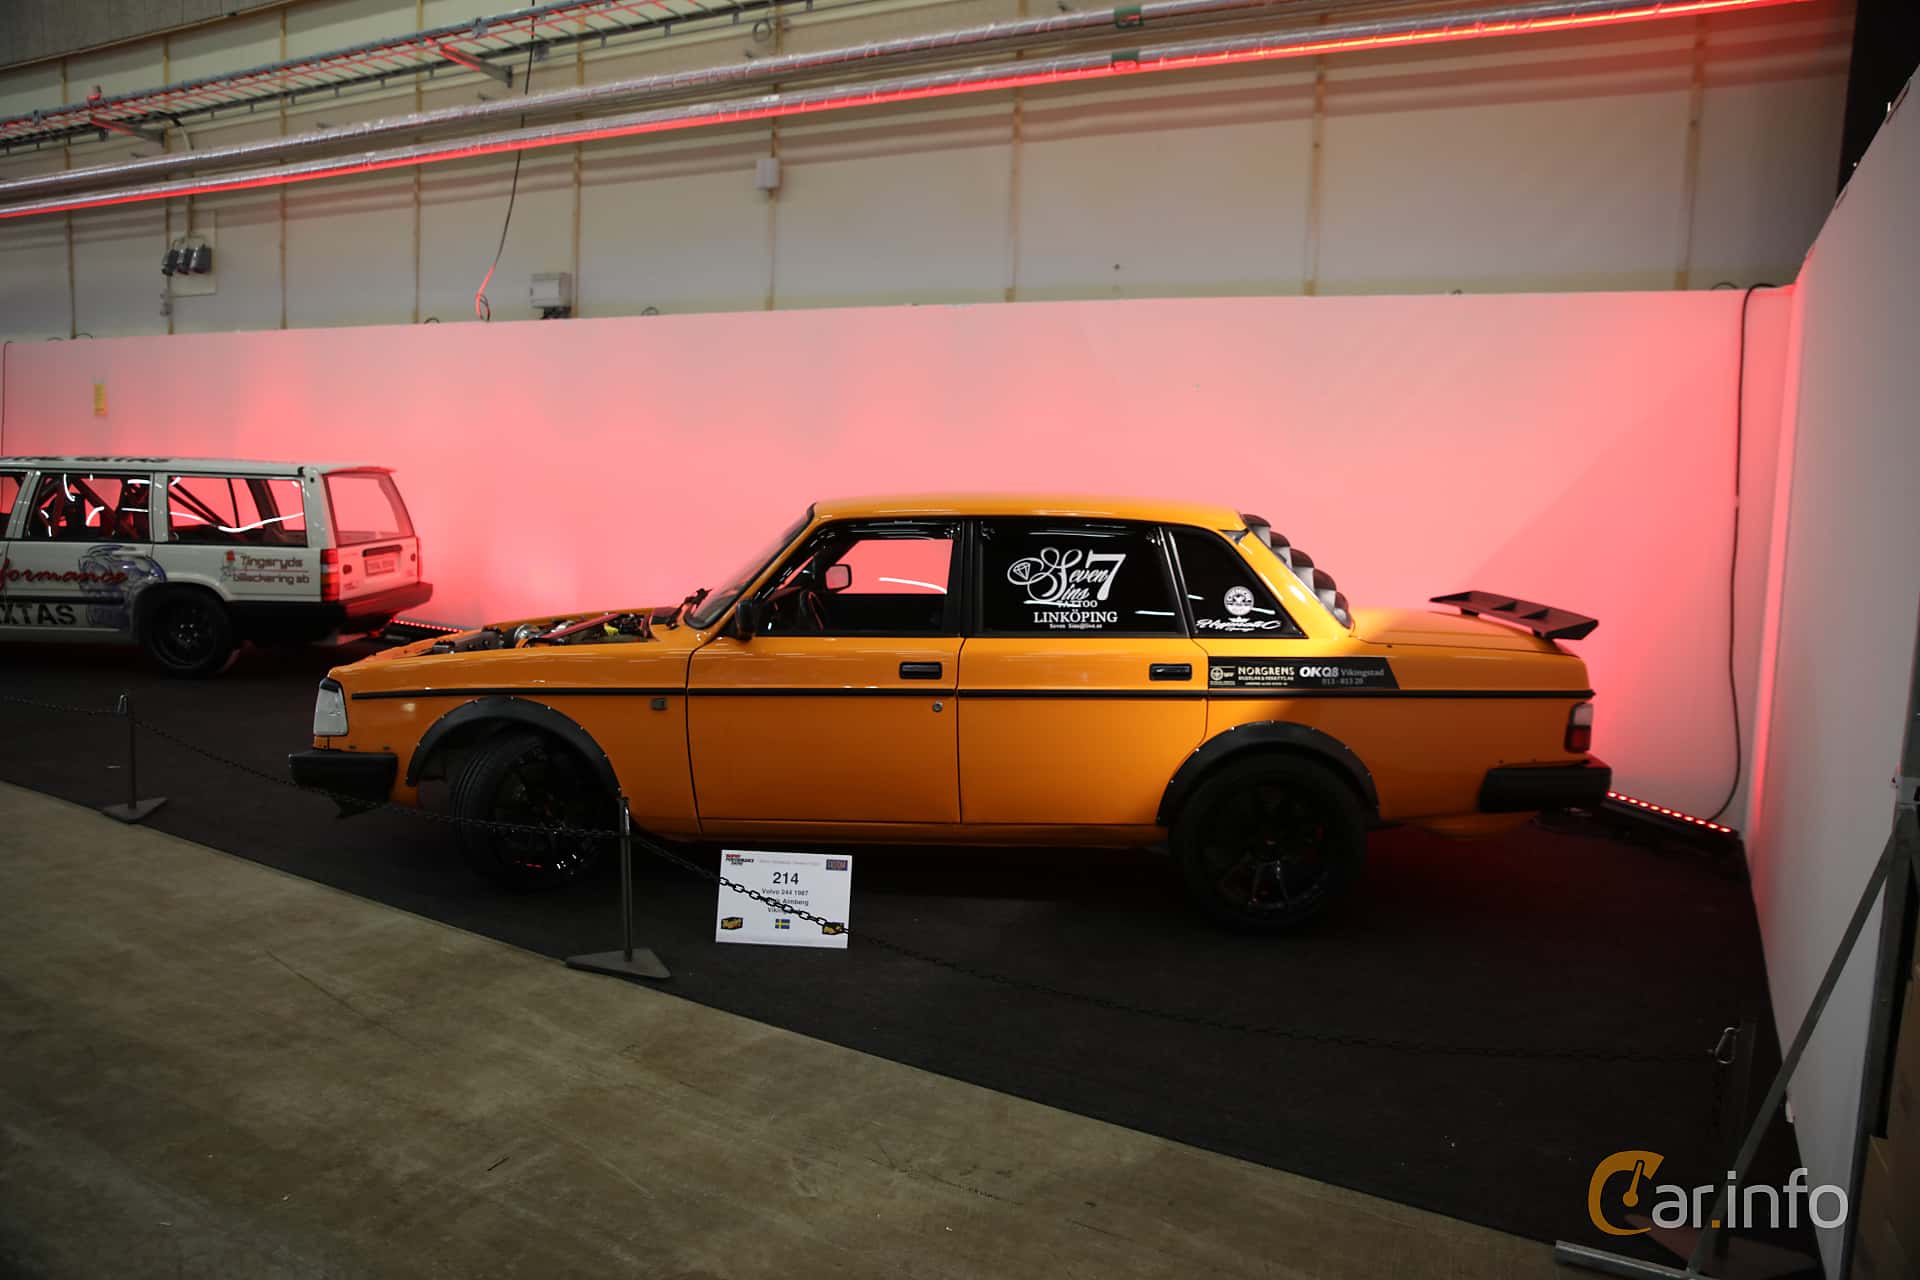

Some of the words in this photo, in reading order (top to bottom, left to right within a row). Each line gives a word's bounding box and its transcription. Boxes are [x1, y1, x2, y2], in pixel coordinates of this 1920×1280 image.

[1085, 549, 1127, 601] 7
[1033, 608, 1119, 623] LINKÖPING
[1237, 666, 1296, 676] NORGRENS
[1299, 666, 1339, 678] OKQ8
[772, 871, 800, 885] 214
